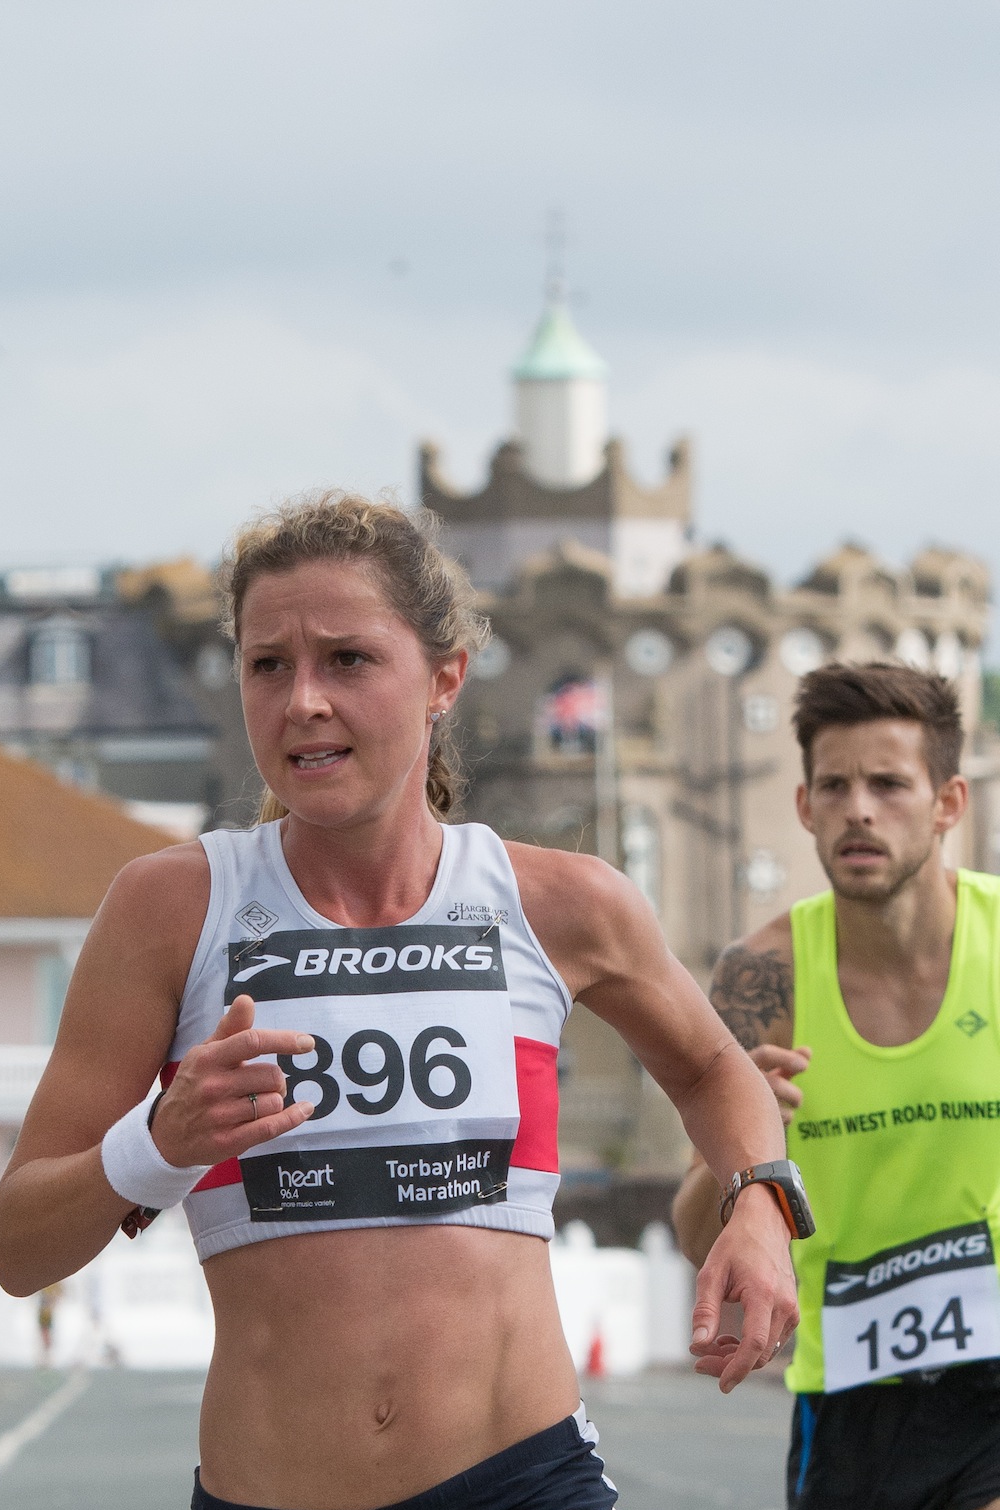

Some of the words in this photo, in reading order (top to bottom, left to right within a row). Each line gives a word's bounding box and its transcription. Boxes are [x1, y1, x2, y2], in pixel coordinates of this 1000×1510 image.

[454, 902, 509, 916] HARGREVES
[294, 944, 494, 977] BROOKS
[276, 1025, 472, 1121] 896
[798, 1118, 842, 1141] SOUTH
[844, 1110, 887, 1133] WEST
[892, 1103, 937, 1125] ROAD
[278, 1164, 335, 1187] heart
[386, 1158, 453, 1179] Torbay
[456, 1151, 491, 1173] Half
[280, 1189, 299, 1199] 96.4
[397, 1180, 480, 1203] Marathon
[865, 1233, 988, 1288] BROOKS
[857, 1295, 973, 1371] 134
